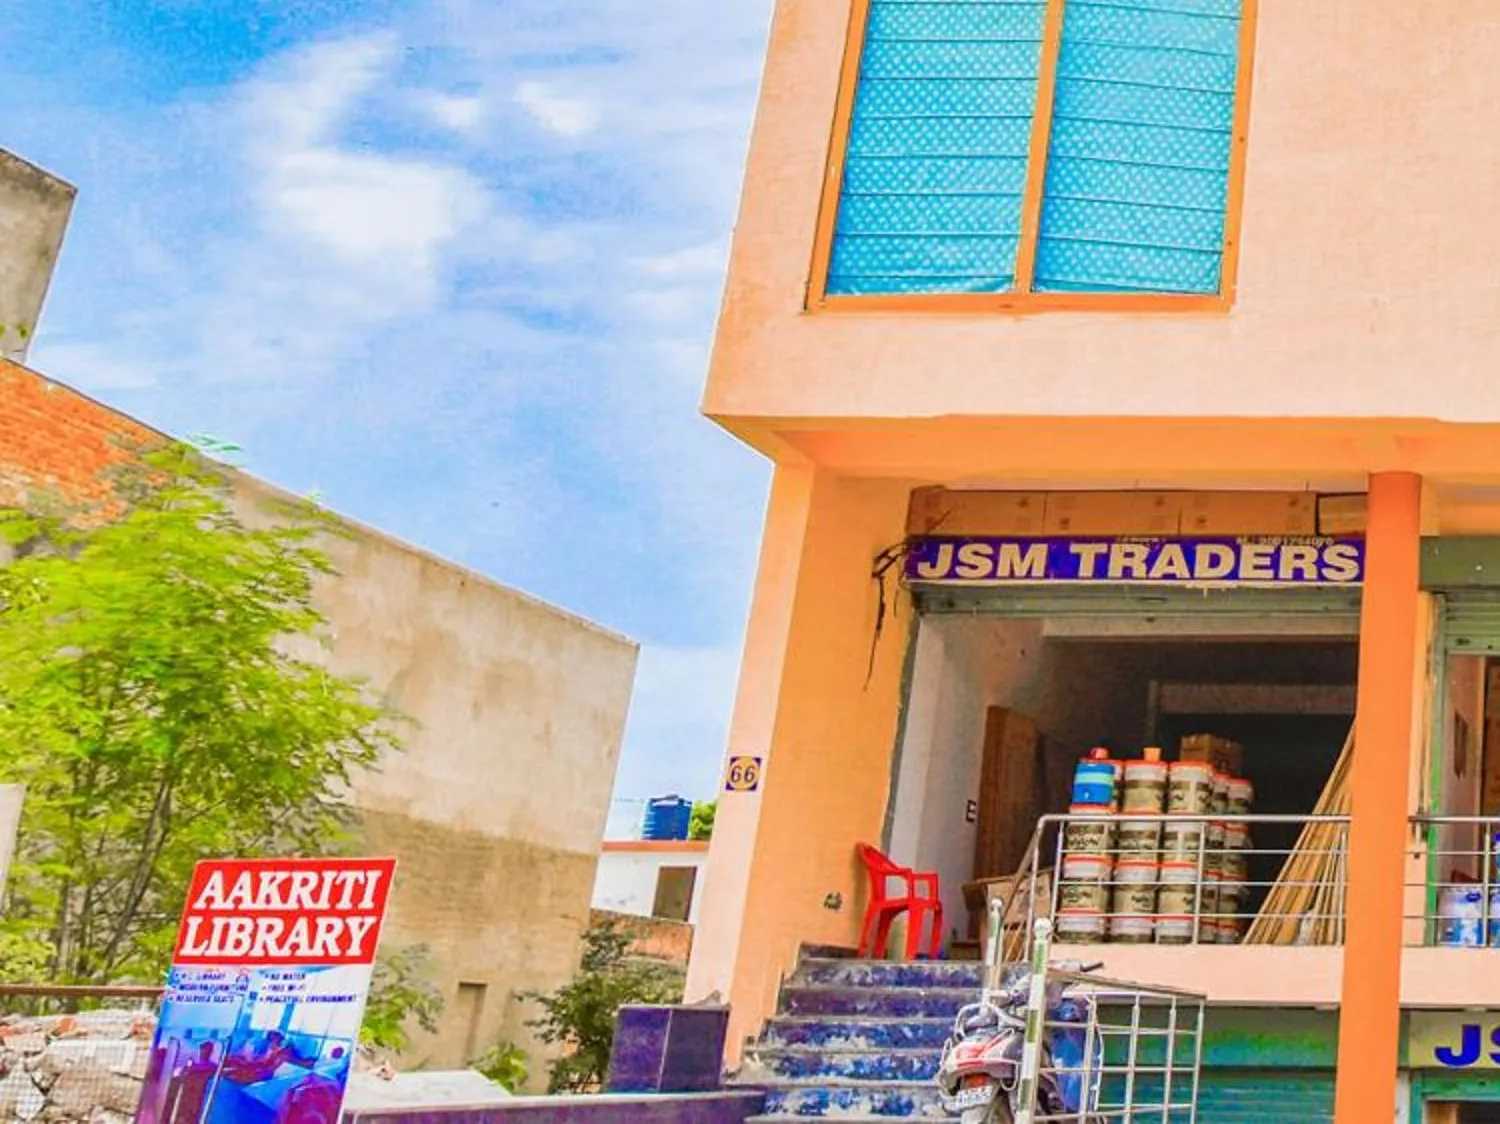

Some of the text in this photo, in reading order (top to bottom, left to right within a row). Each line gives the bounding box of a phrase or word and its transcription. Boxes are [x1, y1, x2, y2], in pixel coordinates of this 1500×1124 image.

[918, 543, 1361, 581] JSM TRADERS
[730, 765, 756, 783] 66
[193, 869, 383, 911] AAKRITI
[179, 916, 377, 958] LIBRARY
